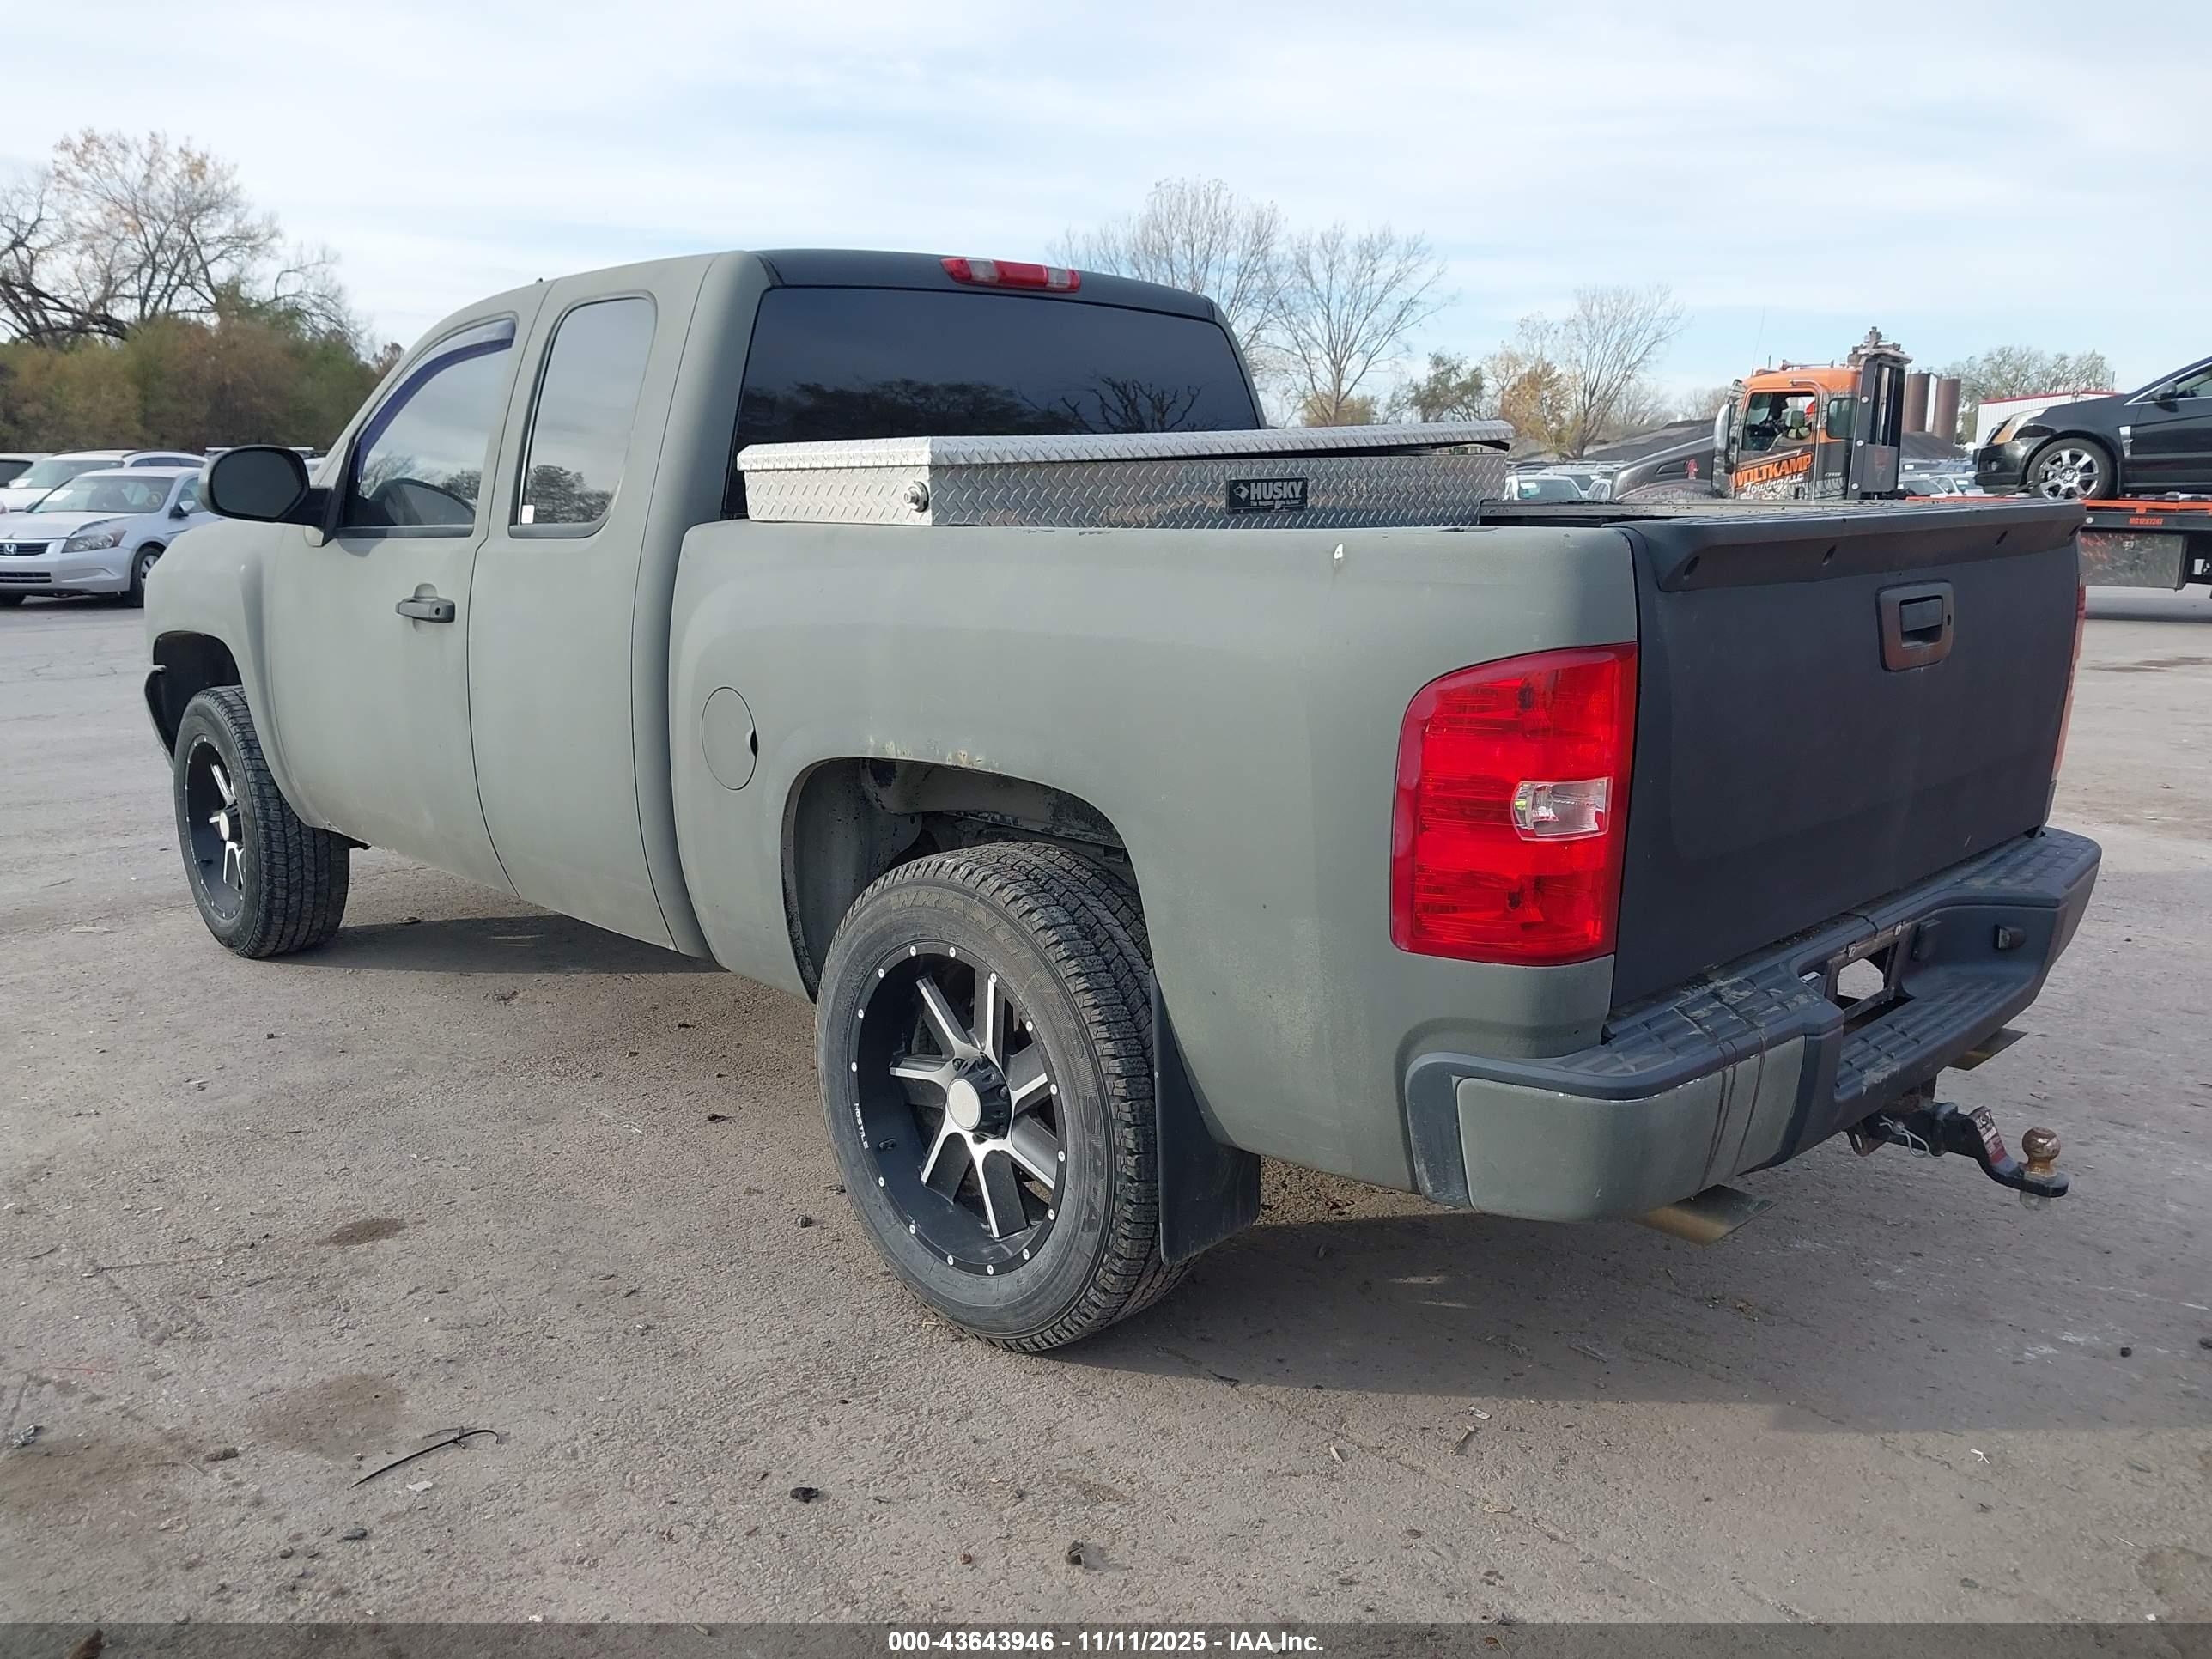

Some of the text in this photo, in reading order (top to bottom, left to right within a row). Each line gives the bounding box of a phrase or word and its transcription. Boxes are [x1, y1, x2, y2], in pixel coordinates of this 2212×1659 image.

[1735, 453, 1812, 487] VOLTKAMP
[1250, 481, 1304, 501] HUSKY
[1744, 478, 1784, 495] Towing
[854, 1103, 869, 1149] HOSTILE
